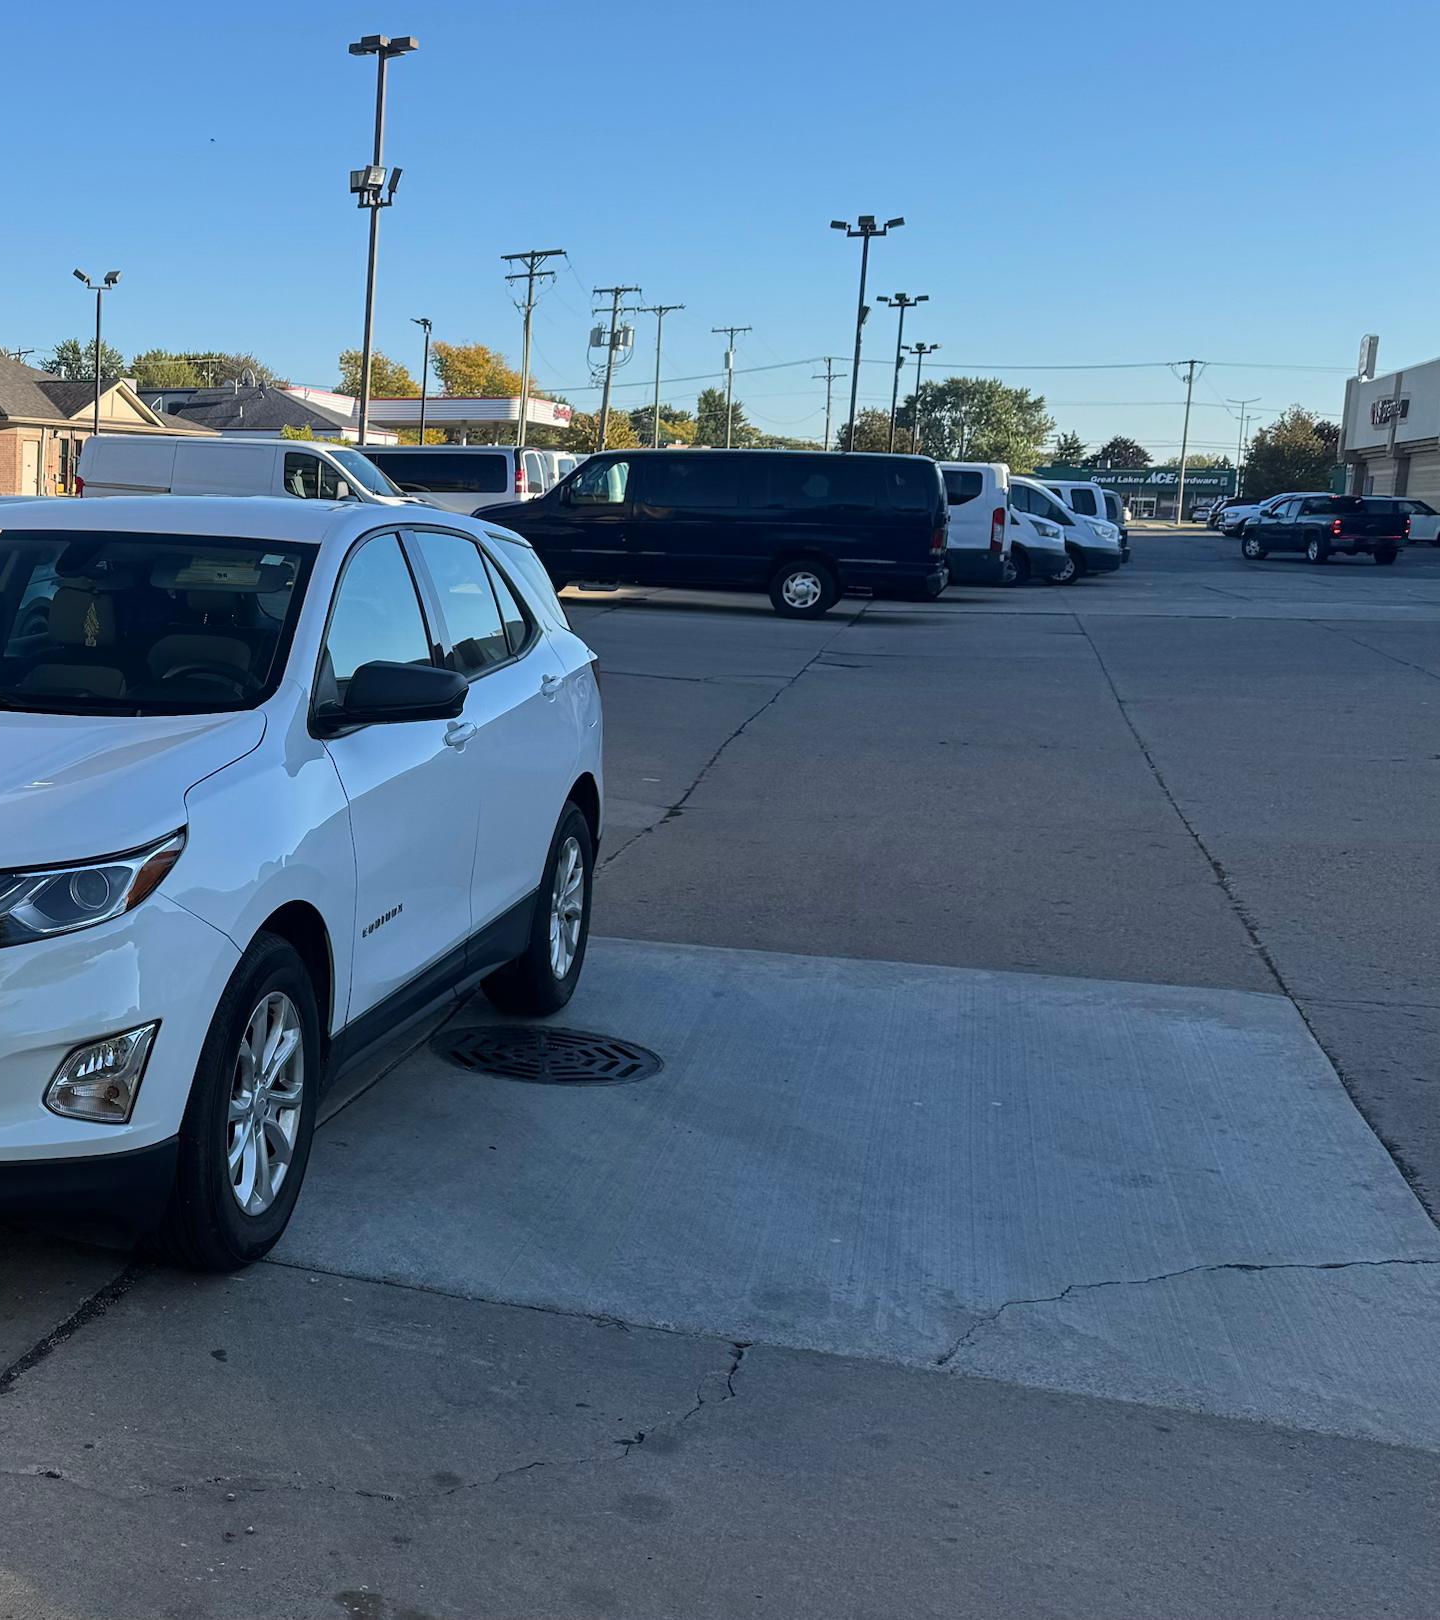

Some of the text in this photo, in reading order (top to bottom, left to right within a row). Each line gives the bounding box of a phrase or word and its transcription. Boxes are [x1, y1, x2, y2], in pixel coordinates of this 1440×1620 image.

[1090, 475, 1116, 483] Great
[1116, 475, 1145, 484] Lakes
[1145, 471, 1176, 485] ACE
